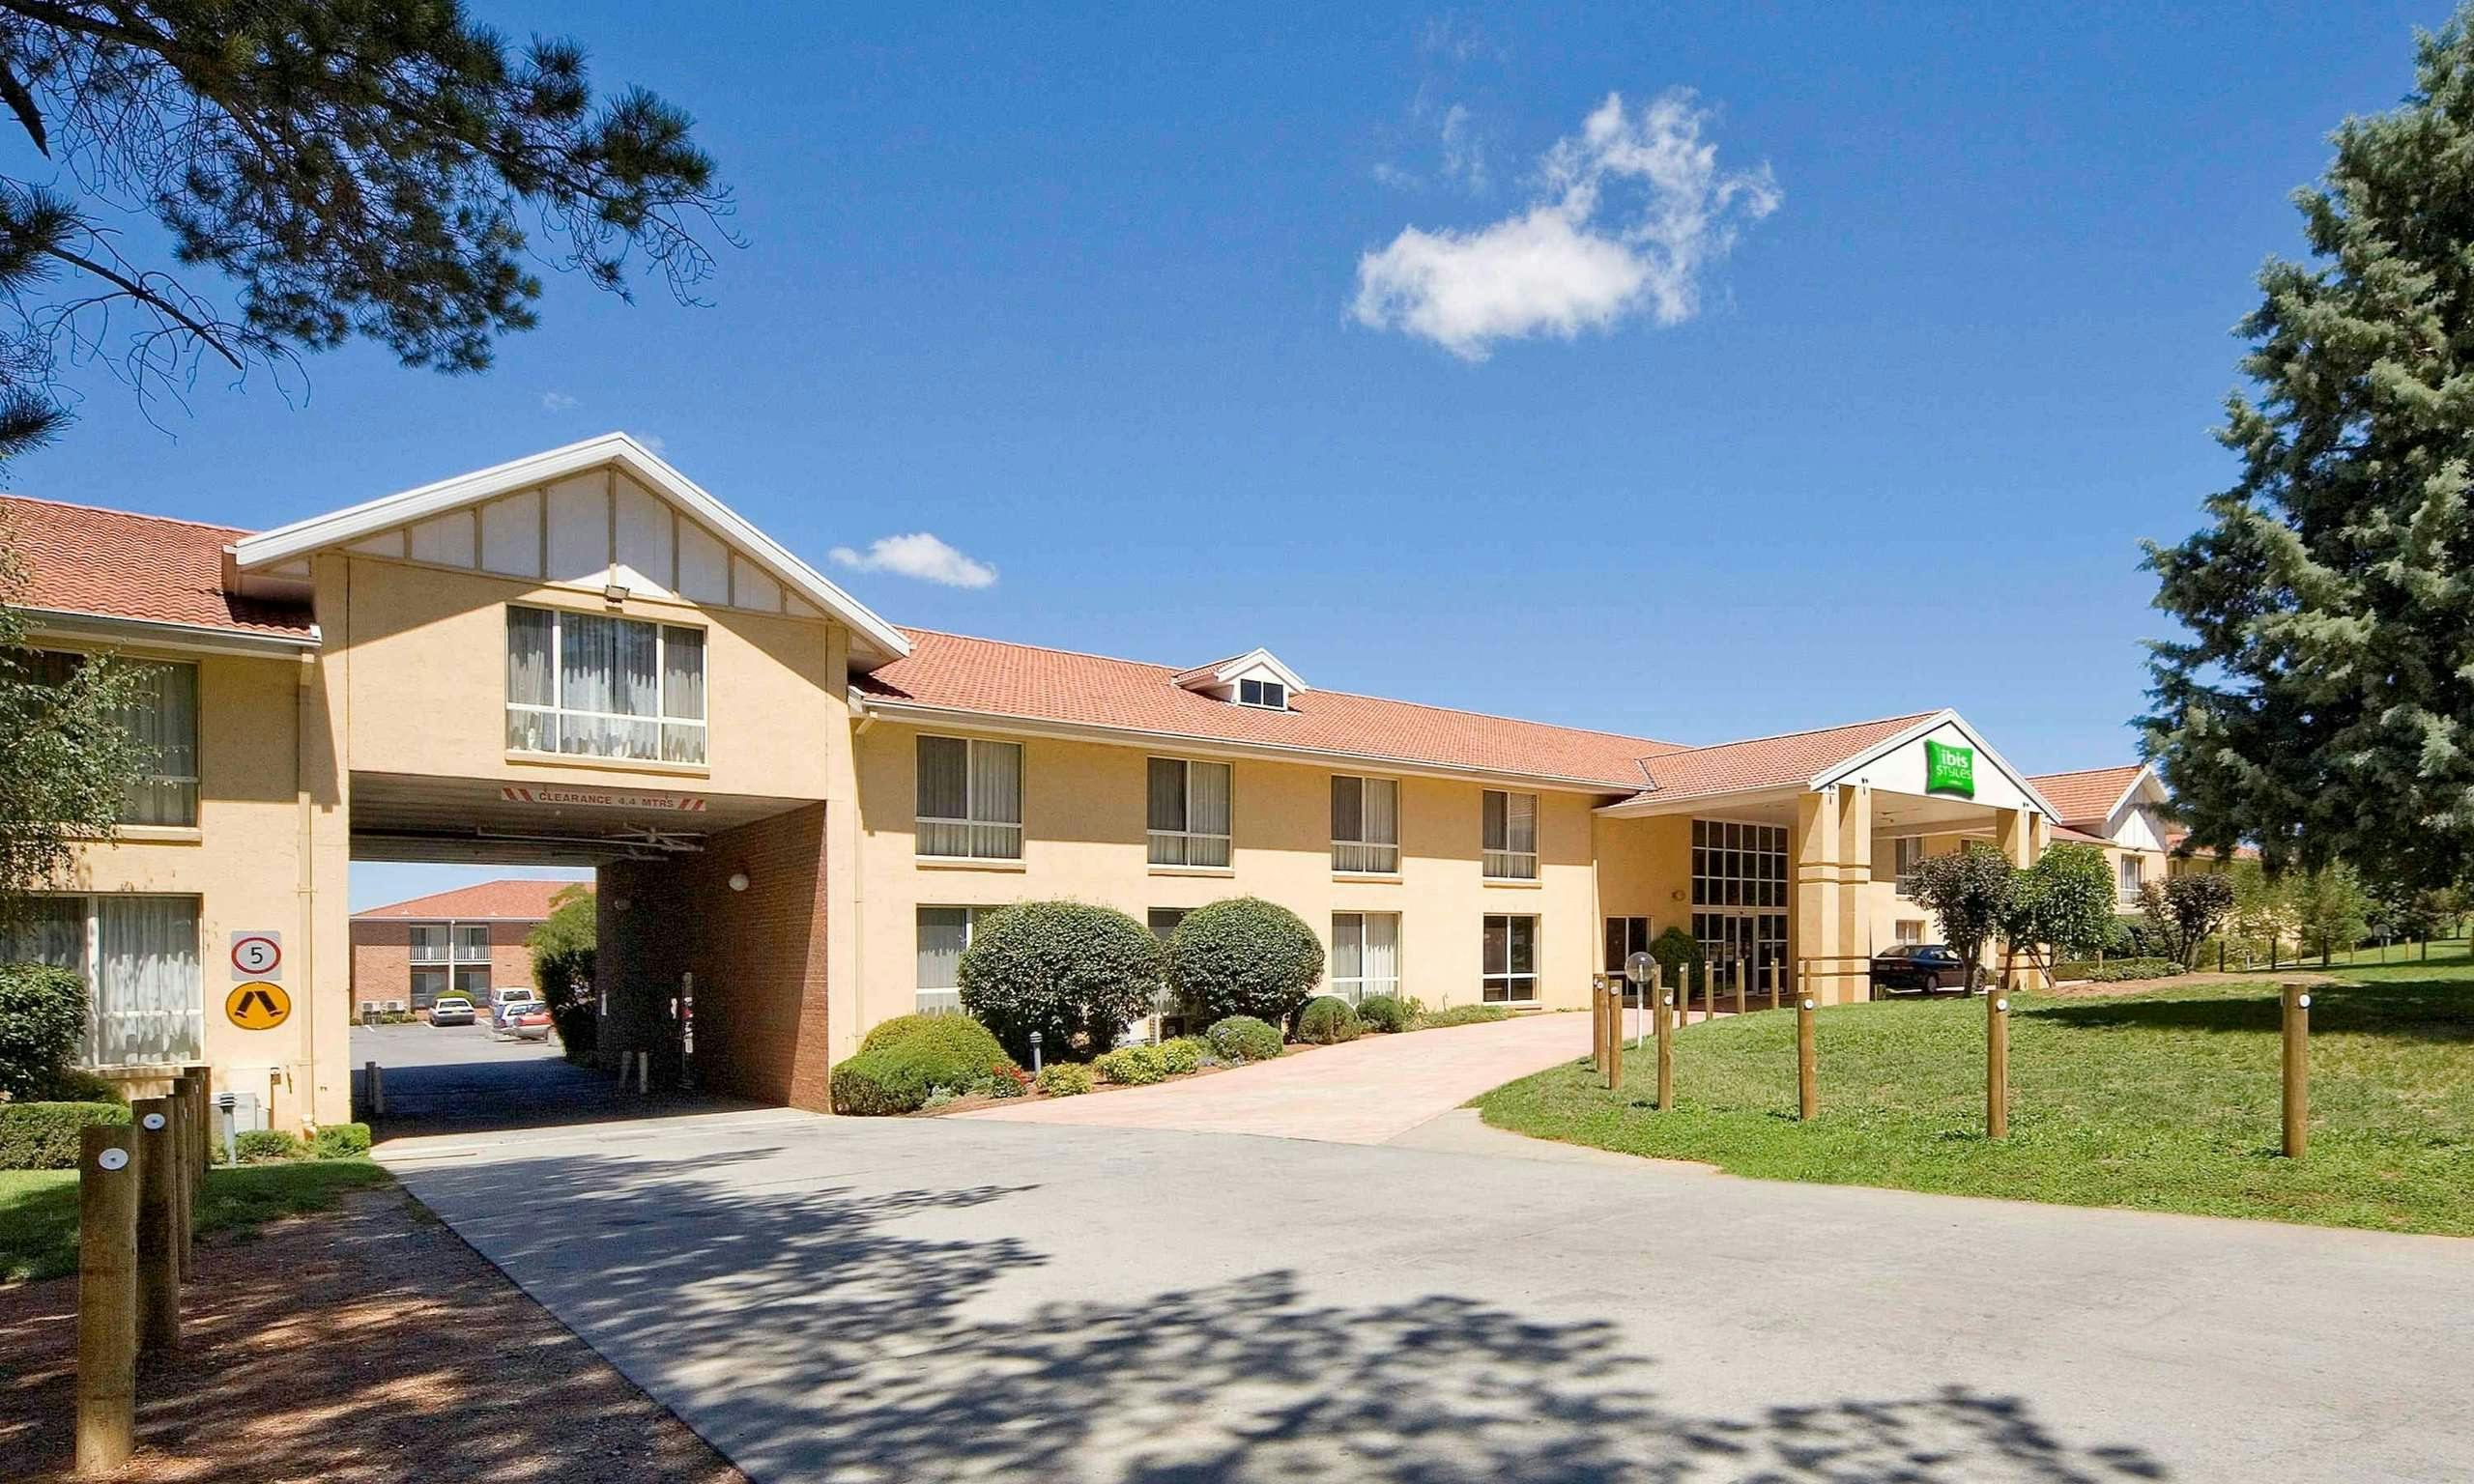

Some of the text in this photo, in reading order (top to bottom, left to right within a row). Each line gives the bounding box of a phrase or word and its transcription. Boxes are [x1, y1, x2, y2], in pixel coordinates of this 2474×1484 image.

[1941, 750, 1969, 768] ibis
[539, 792, 612, 805] CLEARANCE
[641, 798, 674, 808] MTRS
[250, 946, 264, 964] 5
